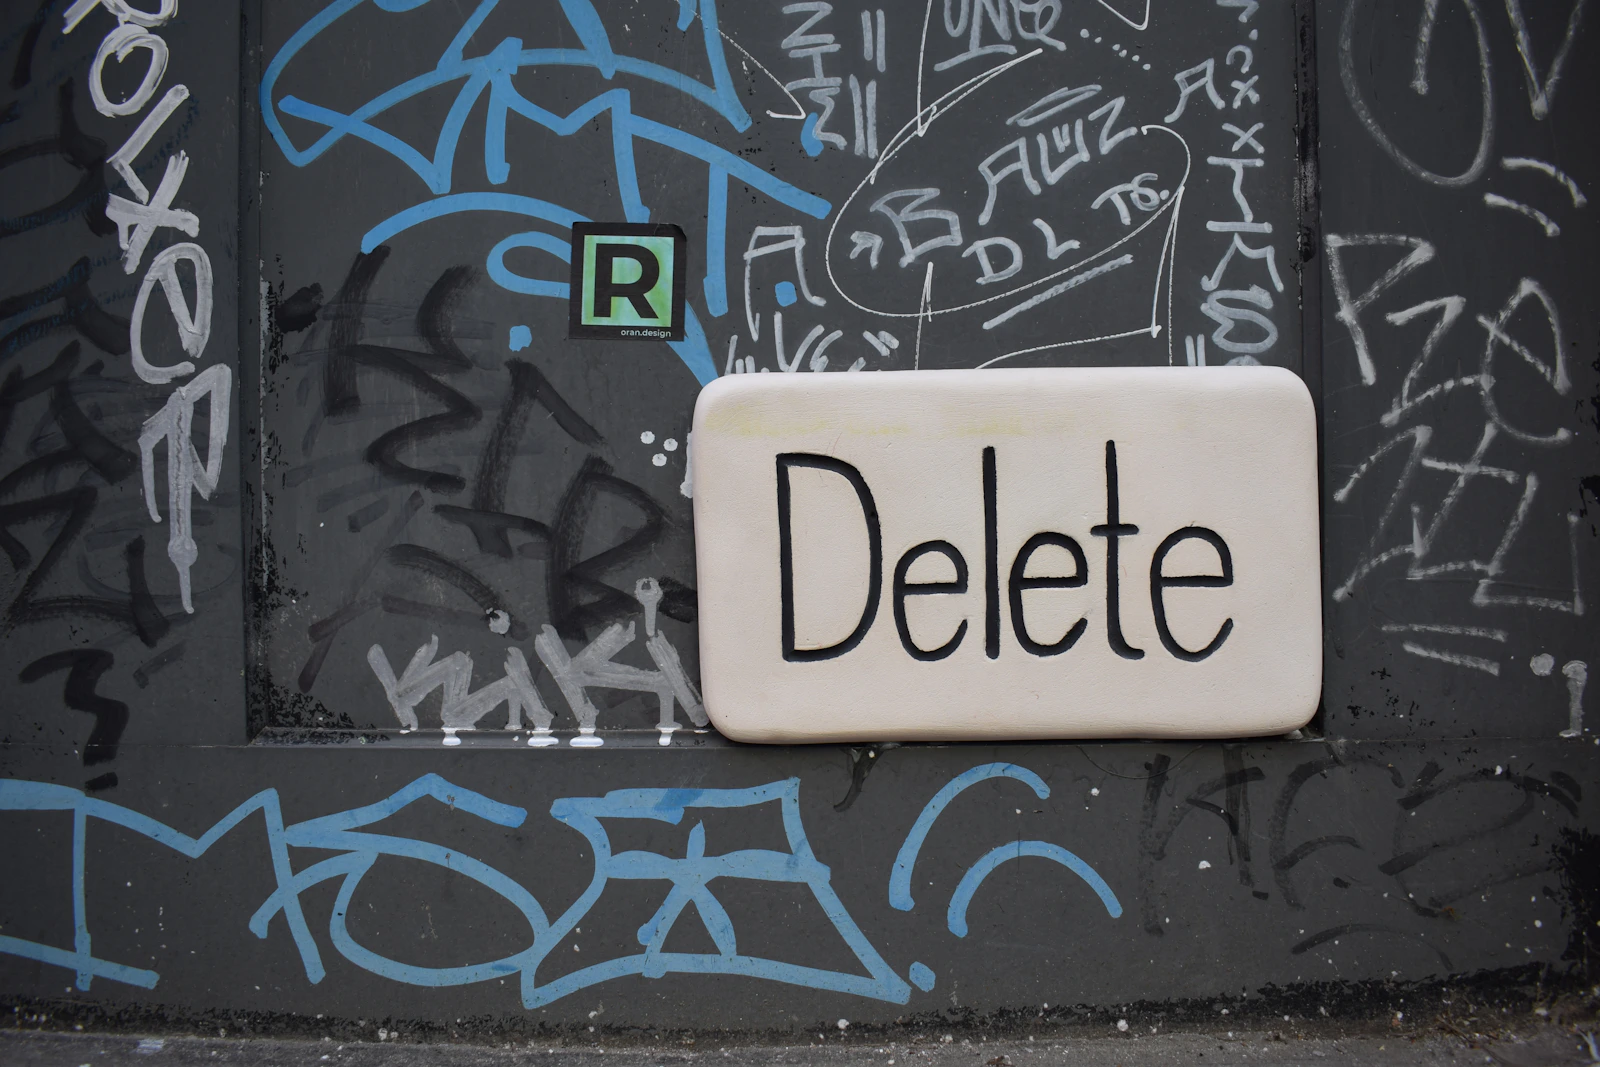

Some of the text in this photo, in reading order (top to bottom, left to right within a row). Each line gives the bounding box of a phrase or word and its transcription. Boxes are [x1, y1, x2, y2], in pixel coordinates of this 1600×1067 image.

[593, 243, 660, 319] R
[620, 328, 672, 339] oran.design
[776, 440, 1234, 663] Delete
